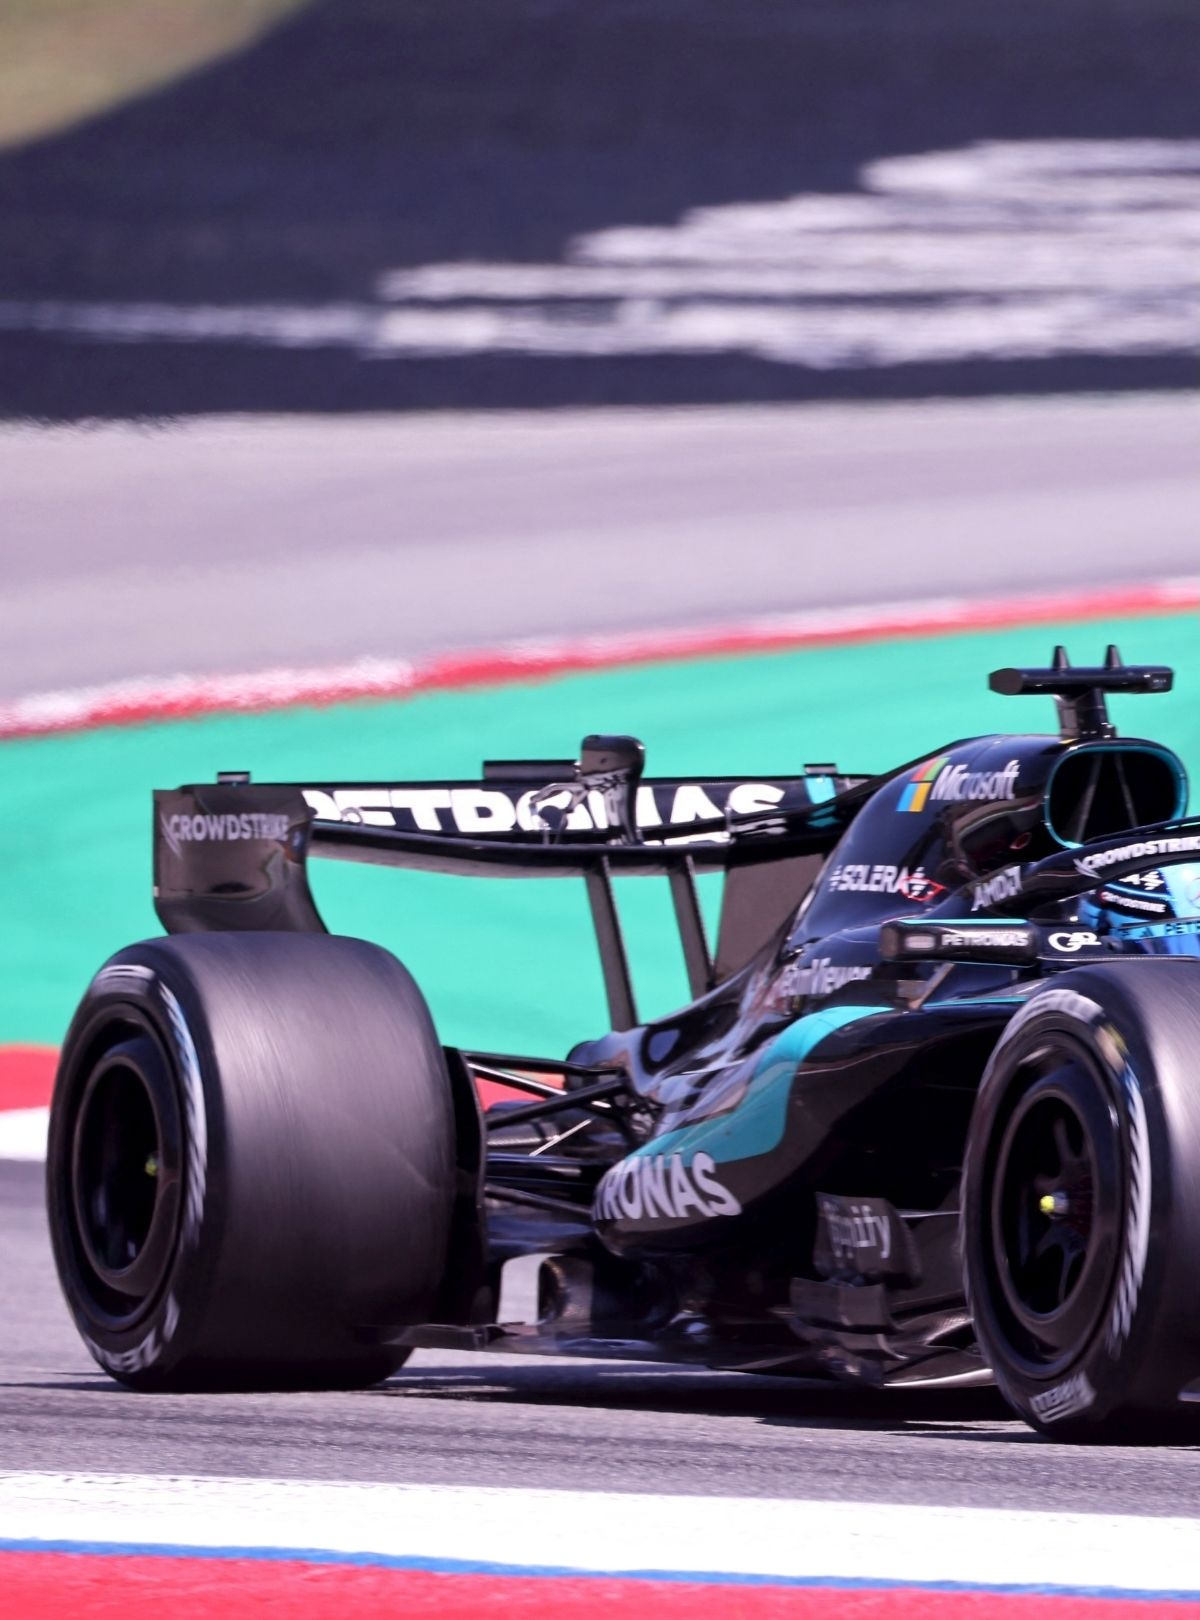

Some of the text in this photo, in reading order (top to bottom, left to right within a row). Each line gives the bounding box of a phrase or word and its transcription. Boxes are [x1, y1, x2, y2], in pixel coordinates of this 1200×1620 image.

[930, 760, 1020, 800] Microsoft
[169, 813, 290, 842] CROWDSTRIKE
[941, 932, 1029, 947] PETRONAS
